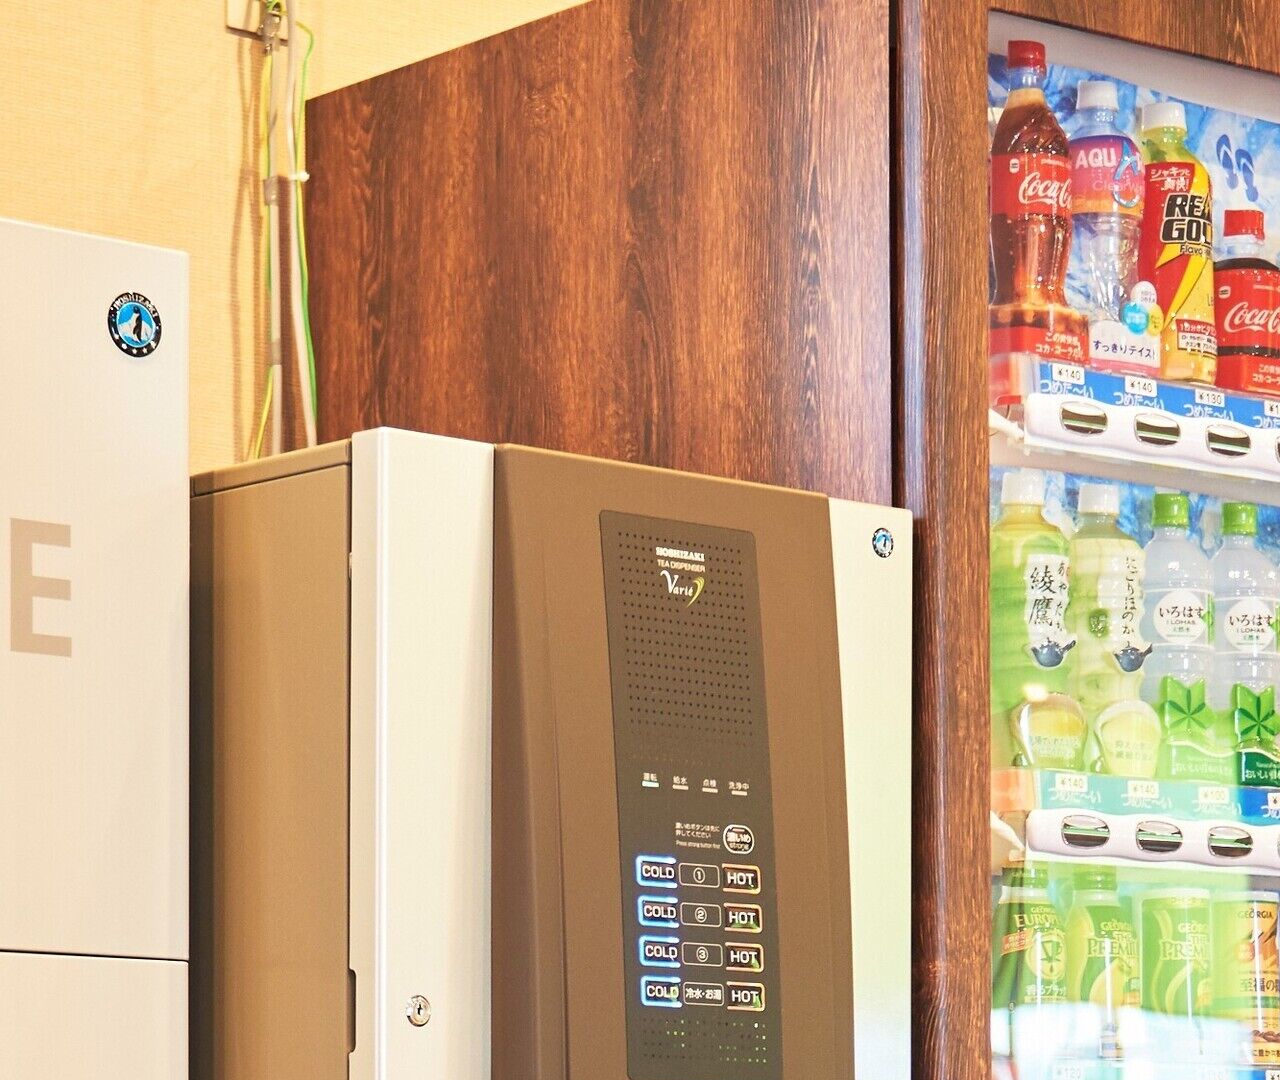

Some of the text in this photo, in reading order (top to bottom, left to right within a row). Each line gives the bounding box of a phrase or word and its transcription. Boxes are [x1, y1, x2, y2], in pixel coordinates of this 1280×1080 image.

[1057, 367, 1082, 381] ¥140
[1129, 380, 1153, 393] ¥140
[642, 864, 675, 879] COLD
[727, 872, 755, 886] HOT
[643, 904, 677, 919] COLD
[728, 910, 756, 926] HOT
[645, 944, 678, 959] COLD
[730, 950, 757, 965] HOT
[646, 984, 680, 999] COLD
[731, 989, 759, 1004] HOT
